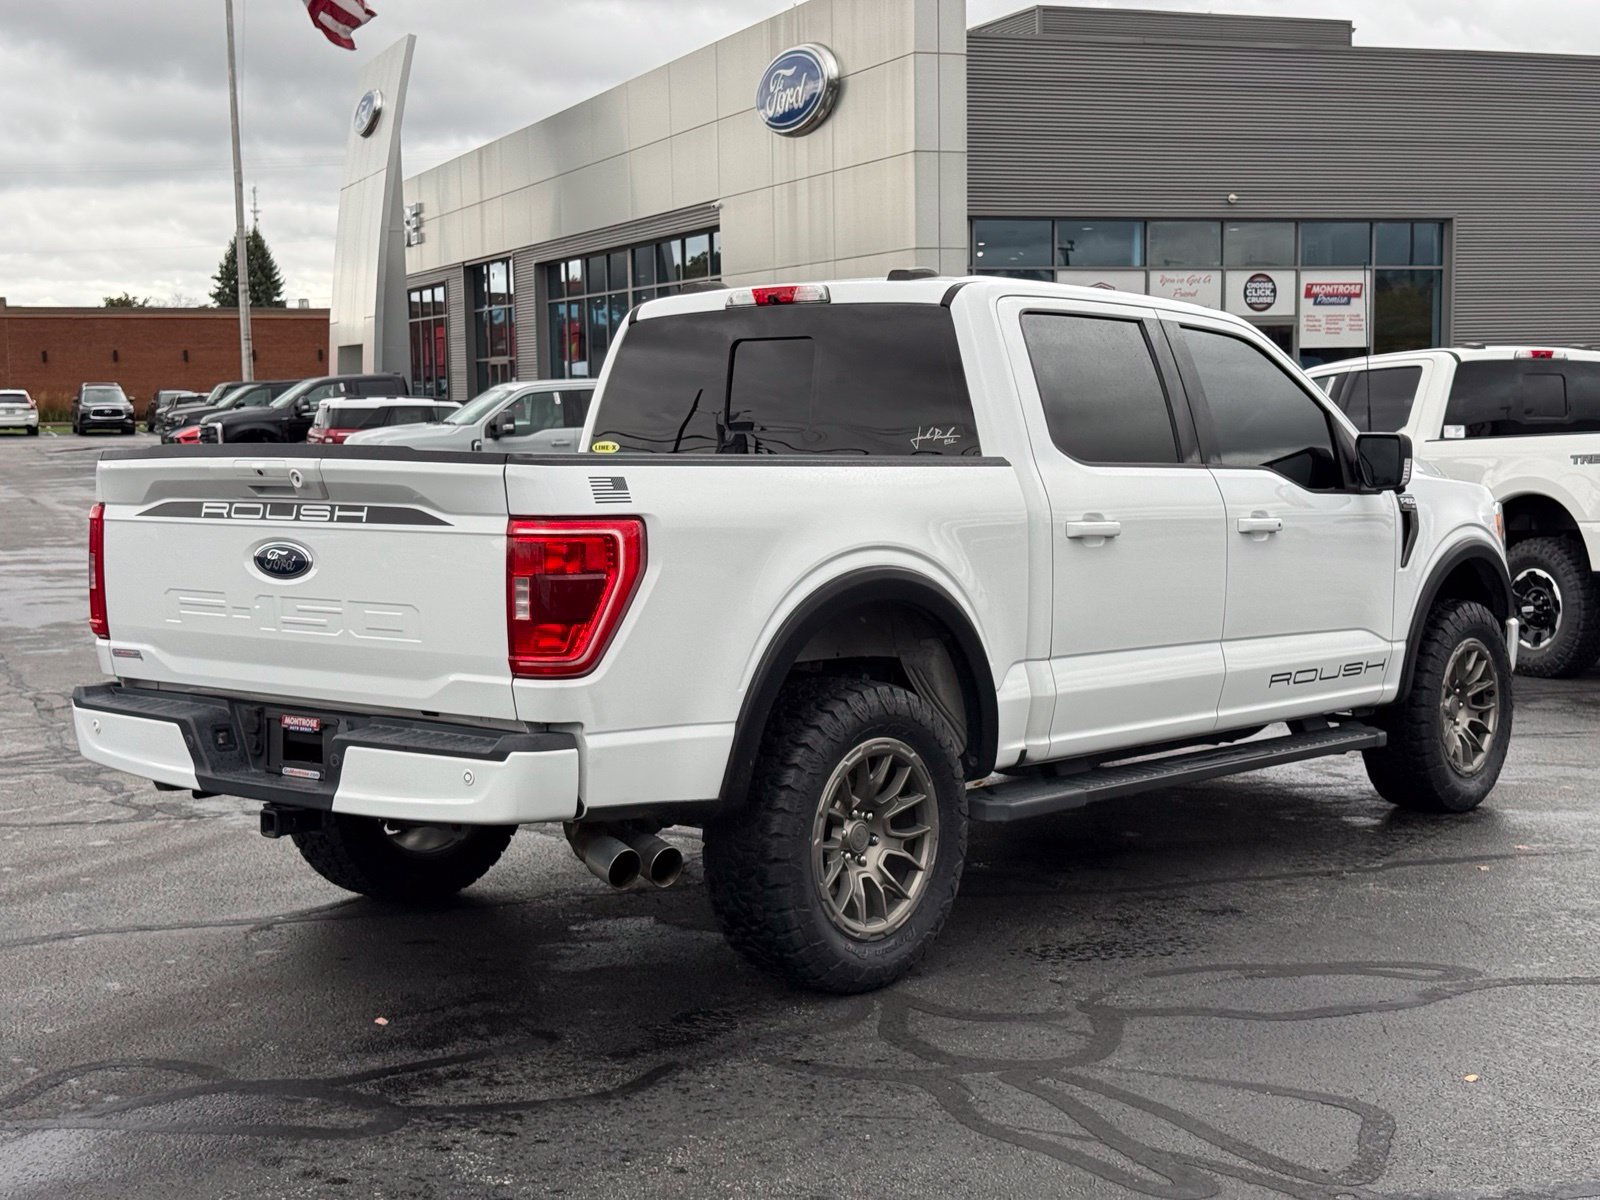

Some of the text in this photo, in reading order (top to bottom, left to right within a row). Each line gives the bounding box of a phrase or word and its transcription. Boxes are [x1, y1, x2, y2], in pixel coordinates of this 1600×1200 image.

[766, 65, 808, 118] Ford
[1311, 284, 1362, 295] MONTROSE
[1316, 295, 1349, 304] Promise
[201, 502, 368, 523] ROUSH
[265, 548, 297, 571] Ford
[164, 587, 422, 643] F-150
[1268, 658, 1387, 689] ROUSH
[284, 716, 318, 728] MONTROSE
